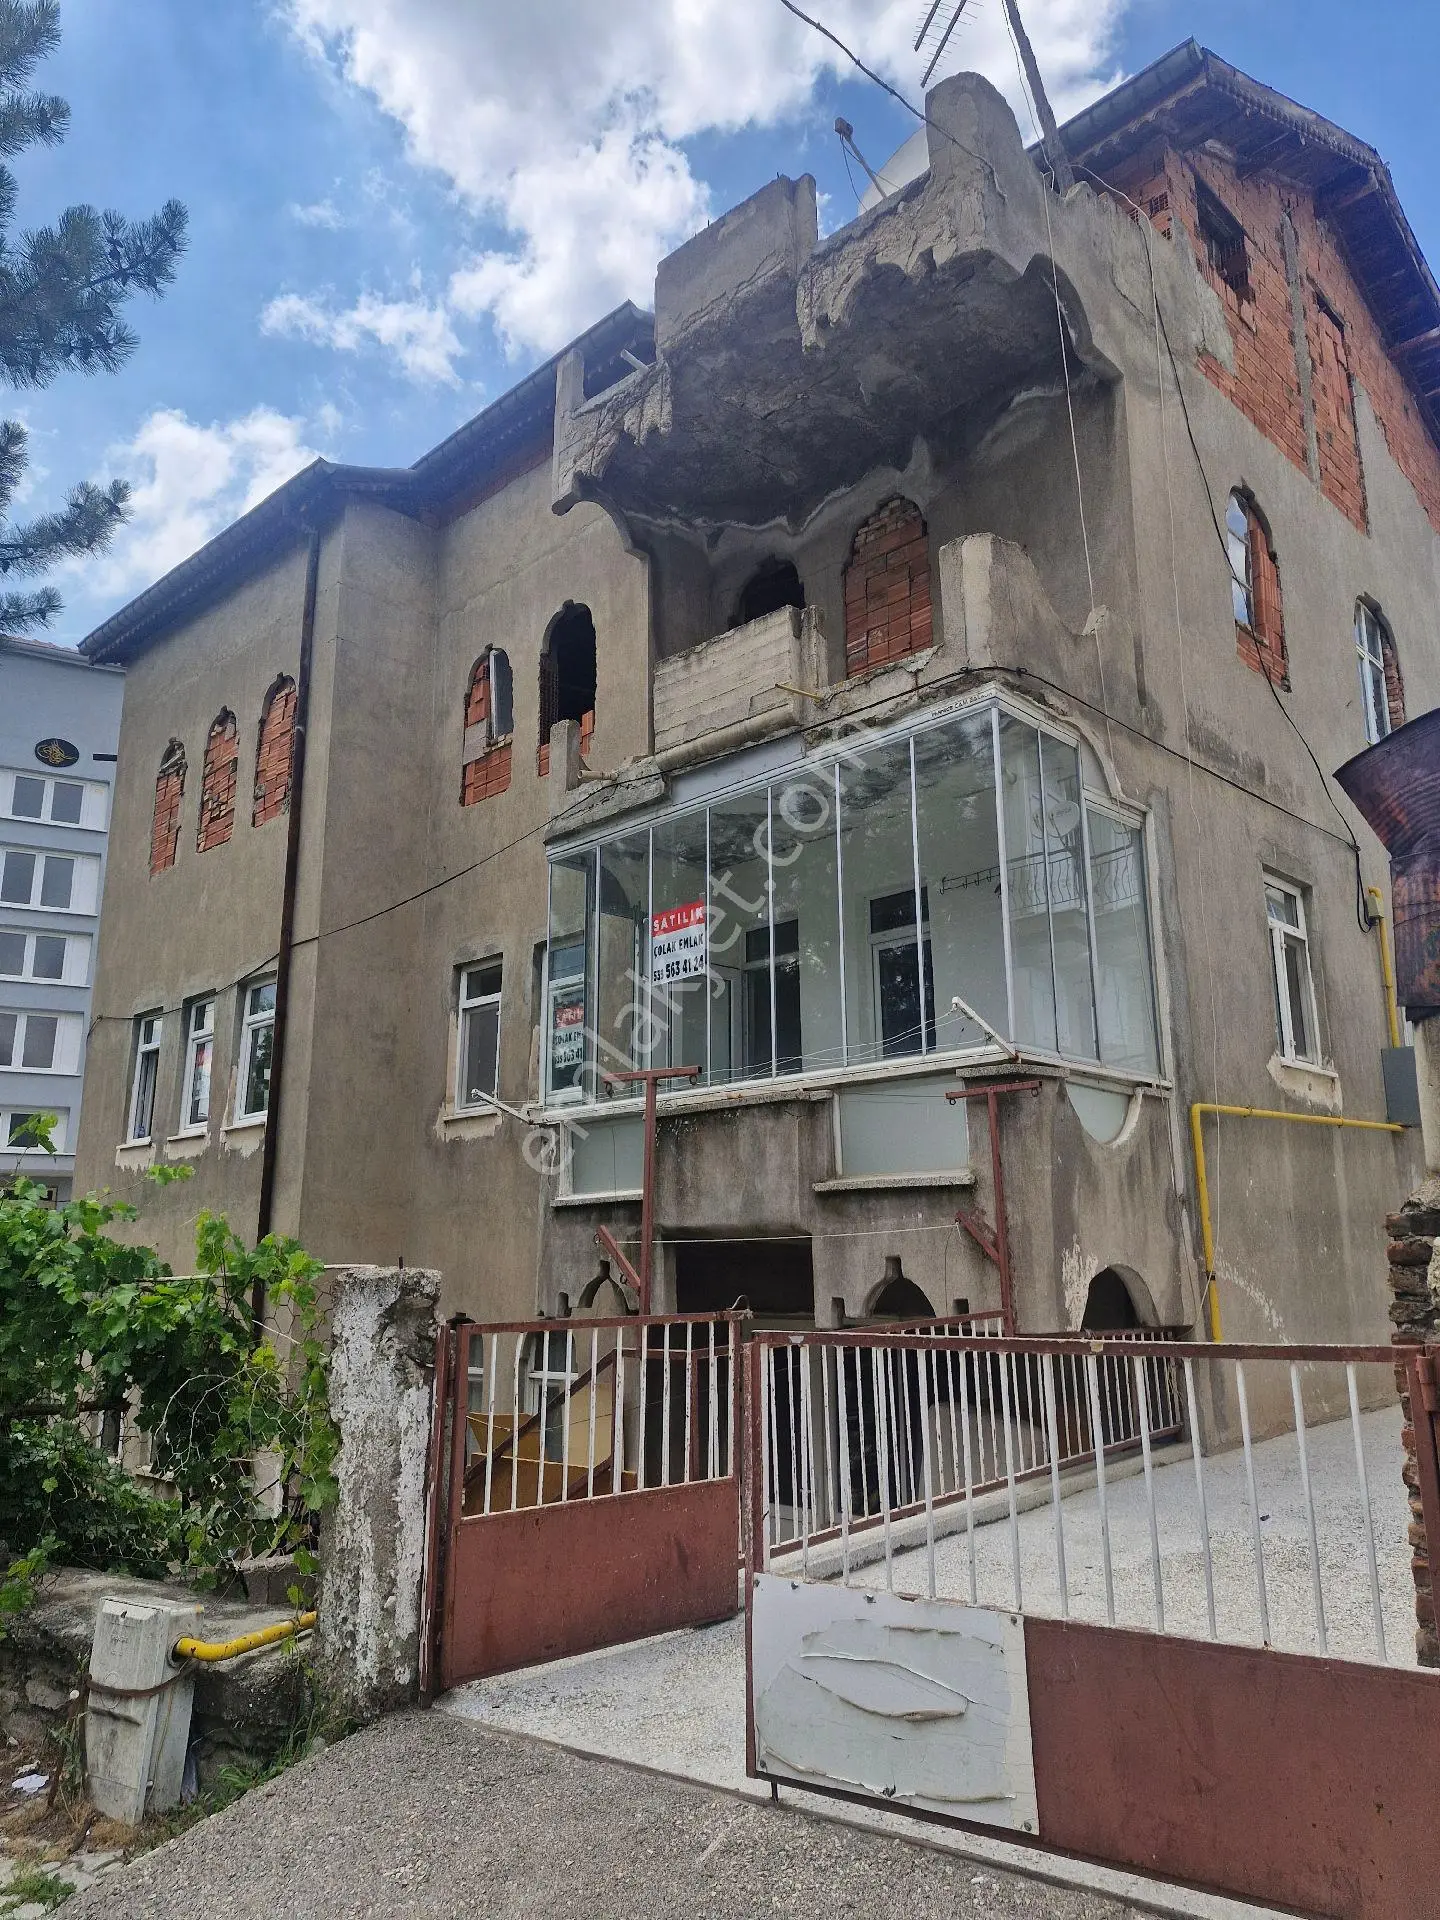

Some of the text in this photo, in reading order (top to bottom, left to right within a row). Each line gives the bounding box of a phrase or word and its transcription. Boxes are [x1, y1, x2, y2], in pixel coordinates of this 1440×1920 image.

[653, 906, 704, 932] SATILIK
[679, 933, 704, 950] EMLAK
[666, 961, 680, 978] 563
[682, 959, 691, 973] 41
